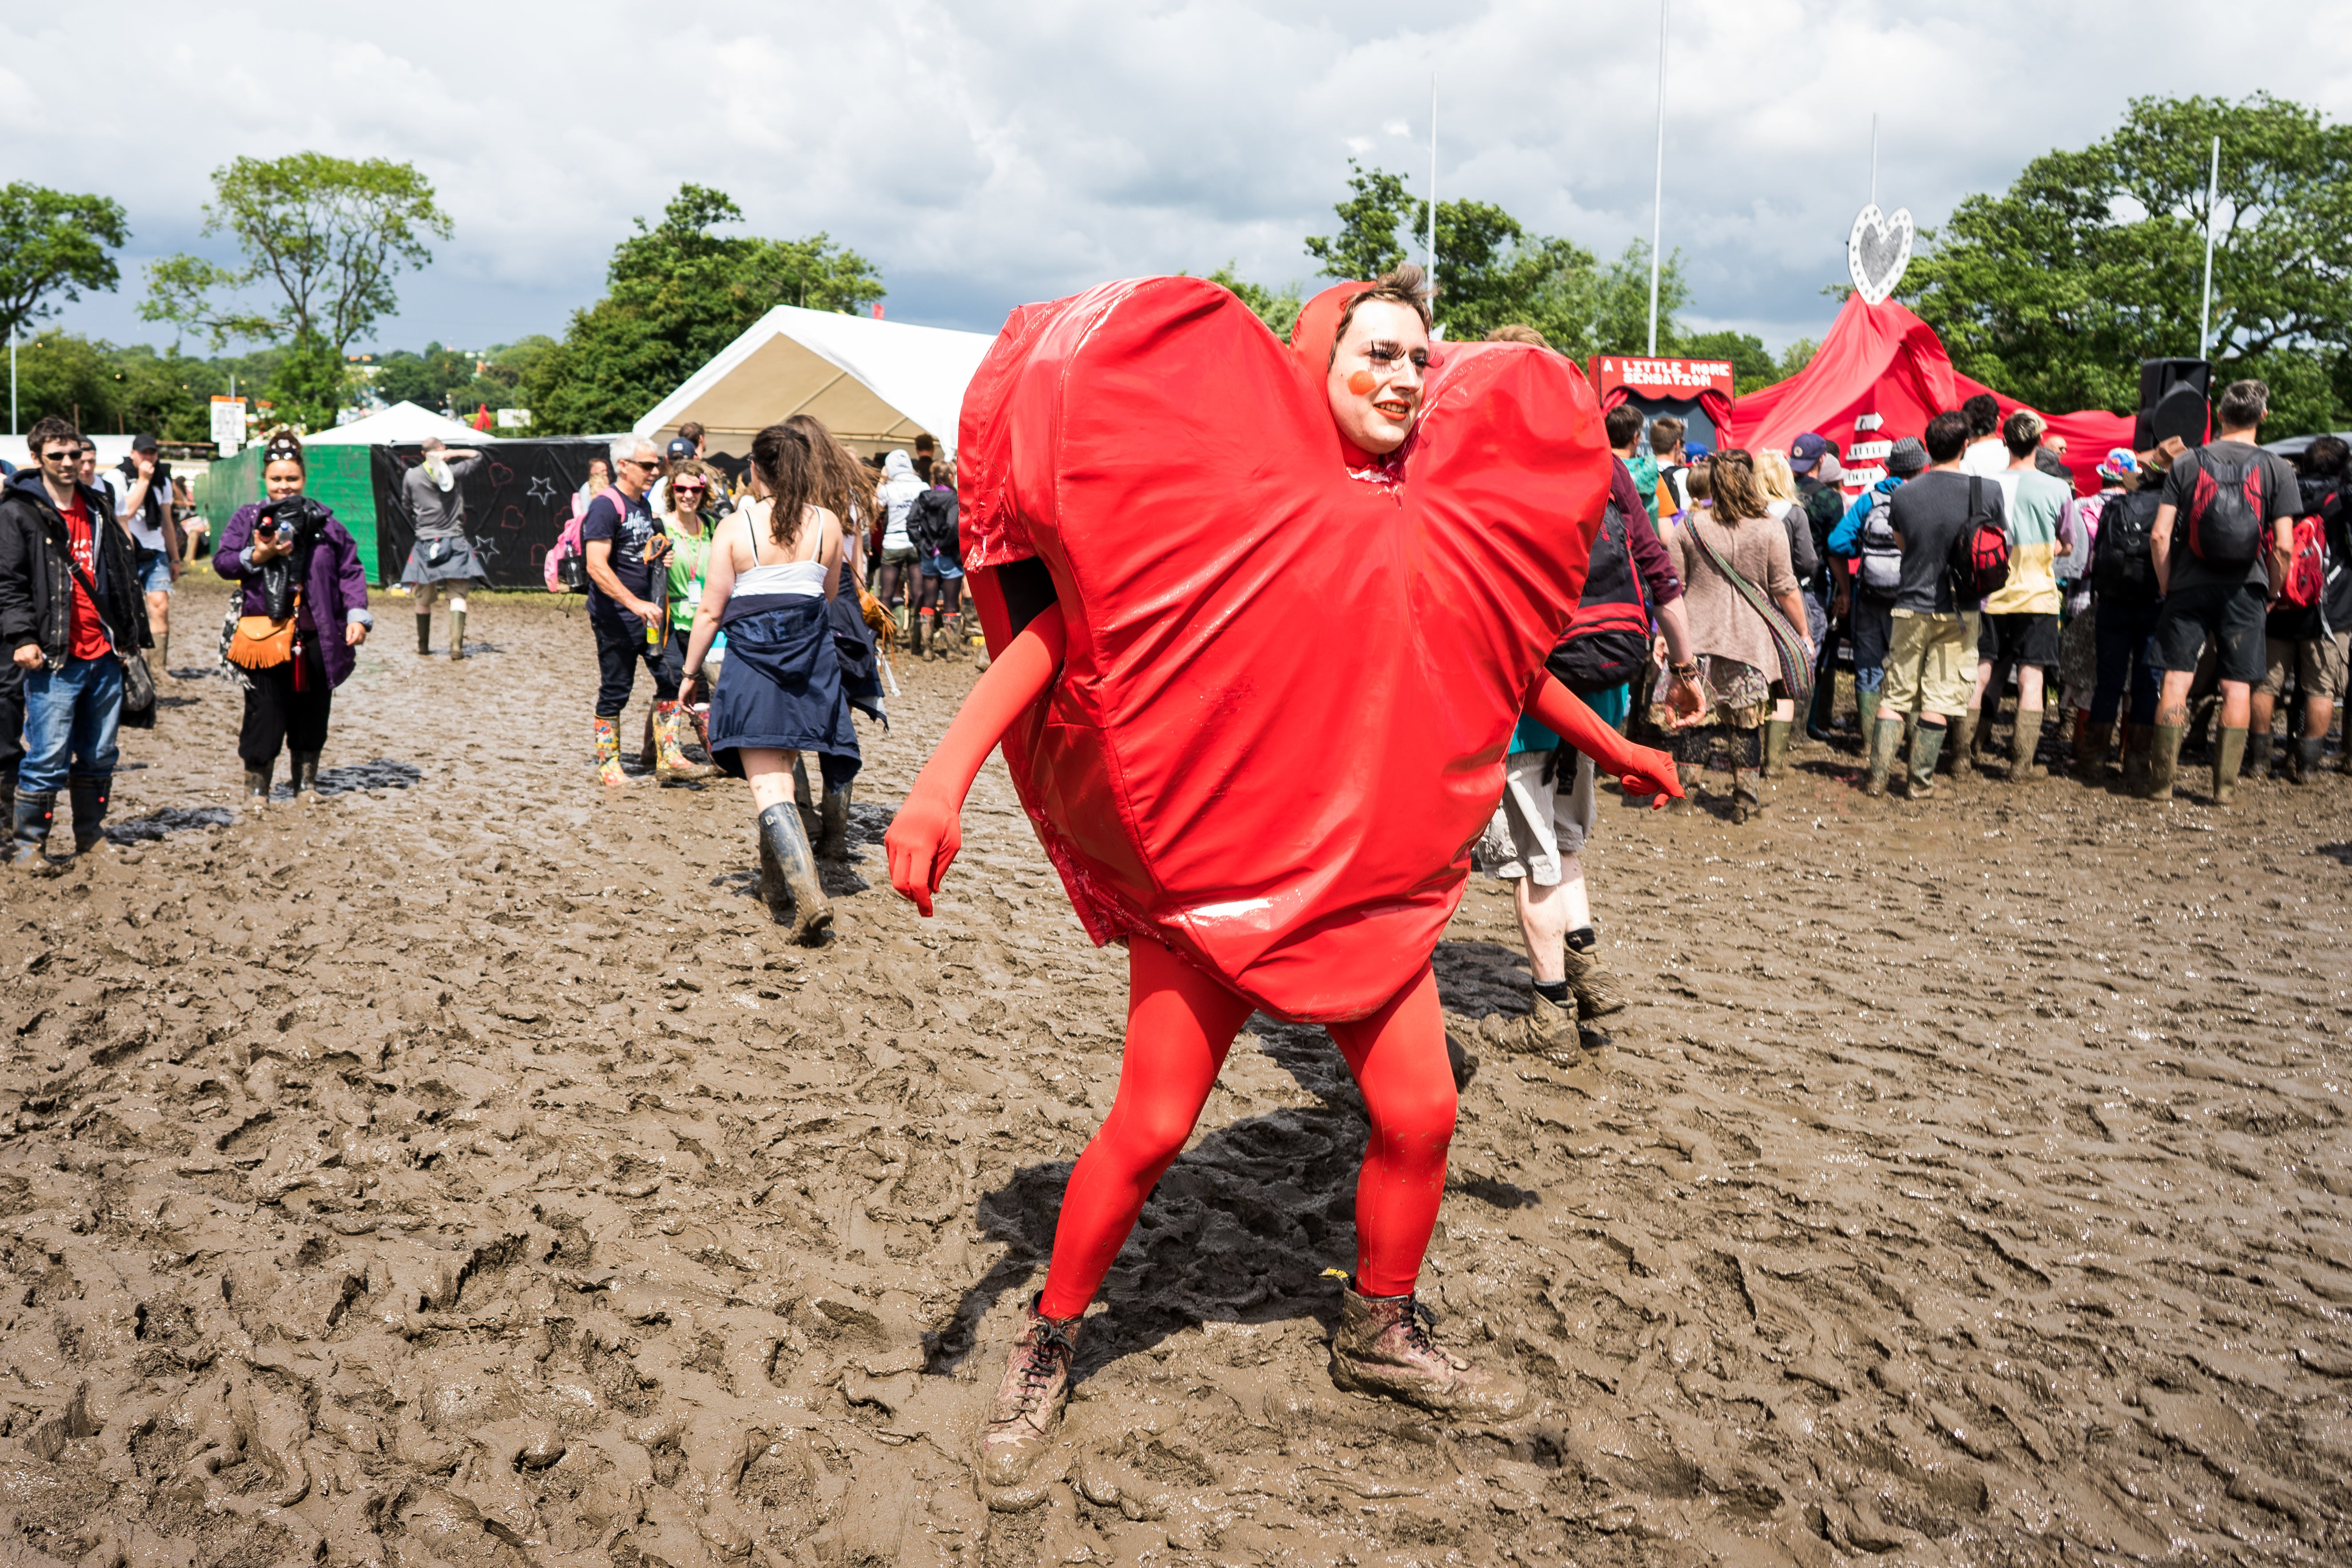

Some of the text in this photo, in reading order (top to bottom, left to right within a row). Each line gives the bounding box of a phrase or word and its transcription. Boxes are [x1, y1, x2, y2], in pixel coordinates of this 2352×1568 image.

[1603, 359, 1730, 376] A LITTLE MORE
[1623, 372, 1711, 386] SENSATION
